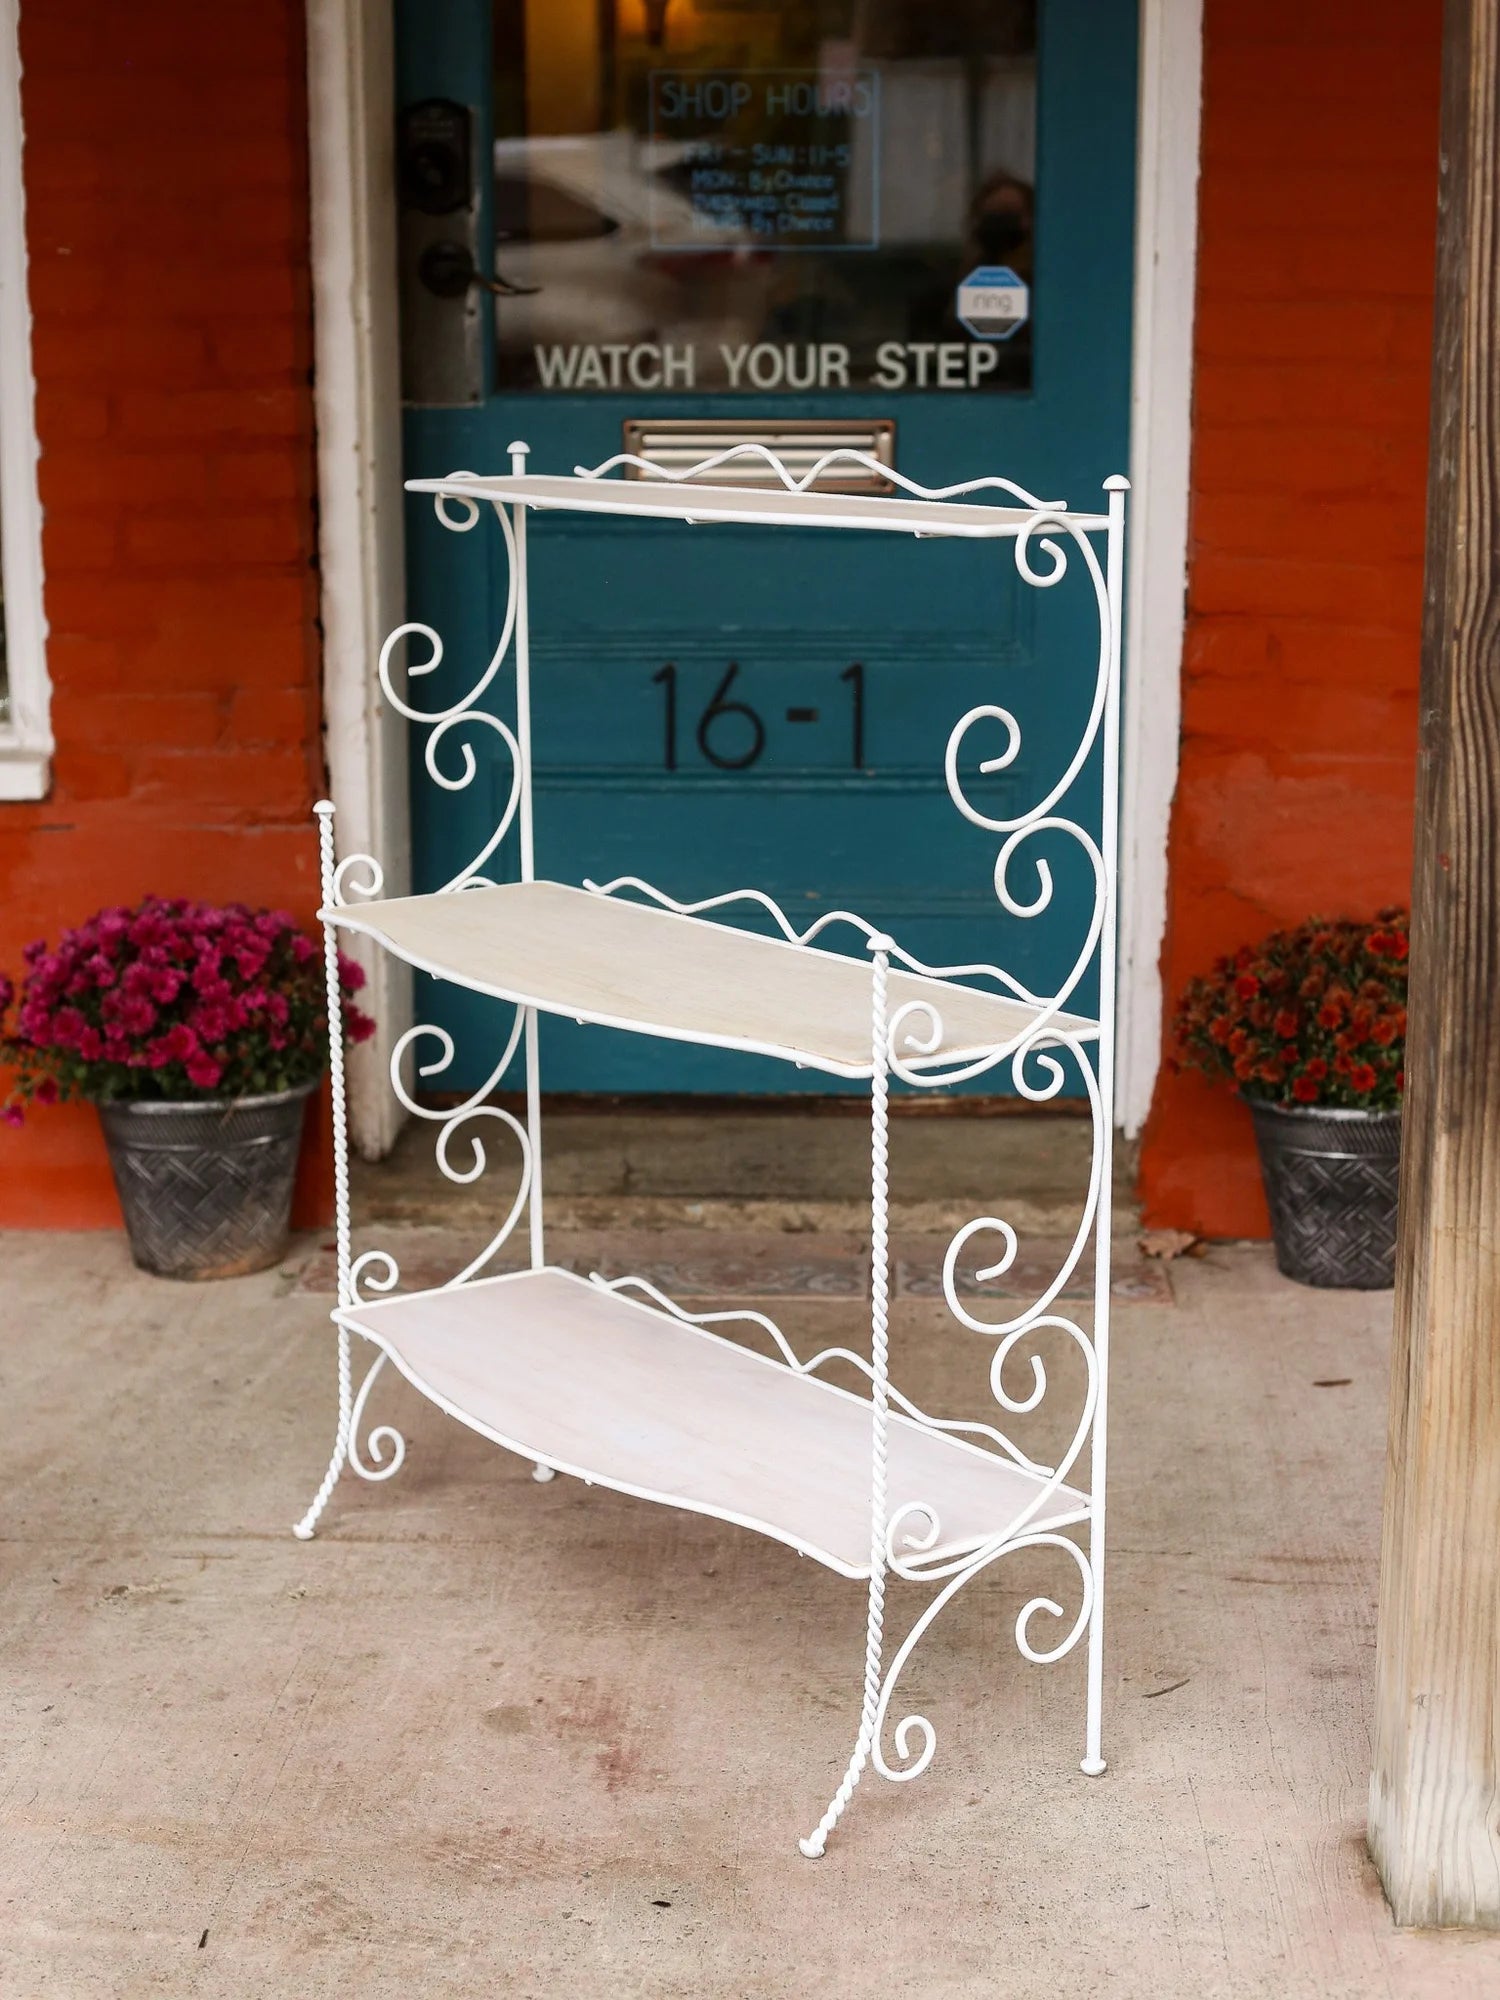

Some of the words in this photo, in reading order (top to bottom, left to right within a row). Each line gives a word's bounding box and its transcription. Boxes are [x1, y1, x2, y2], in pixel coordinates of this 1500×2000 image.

[659, 79, 753, 119] SHOP
[766, 81, 873, 118] HOURS
[973, 290, 1013, 313] ring
[536, 343, 695, 389] WATCH
[721, 343, 850, 389] YOUR
[875, 342, 998, 389] STEP
[652, 660, 865, 771] 16-1
